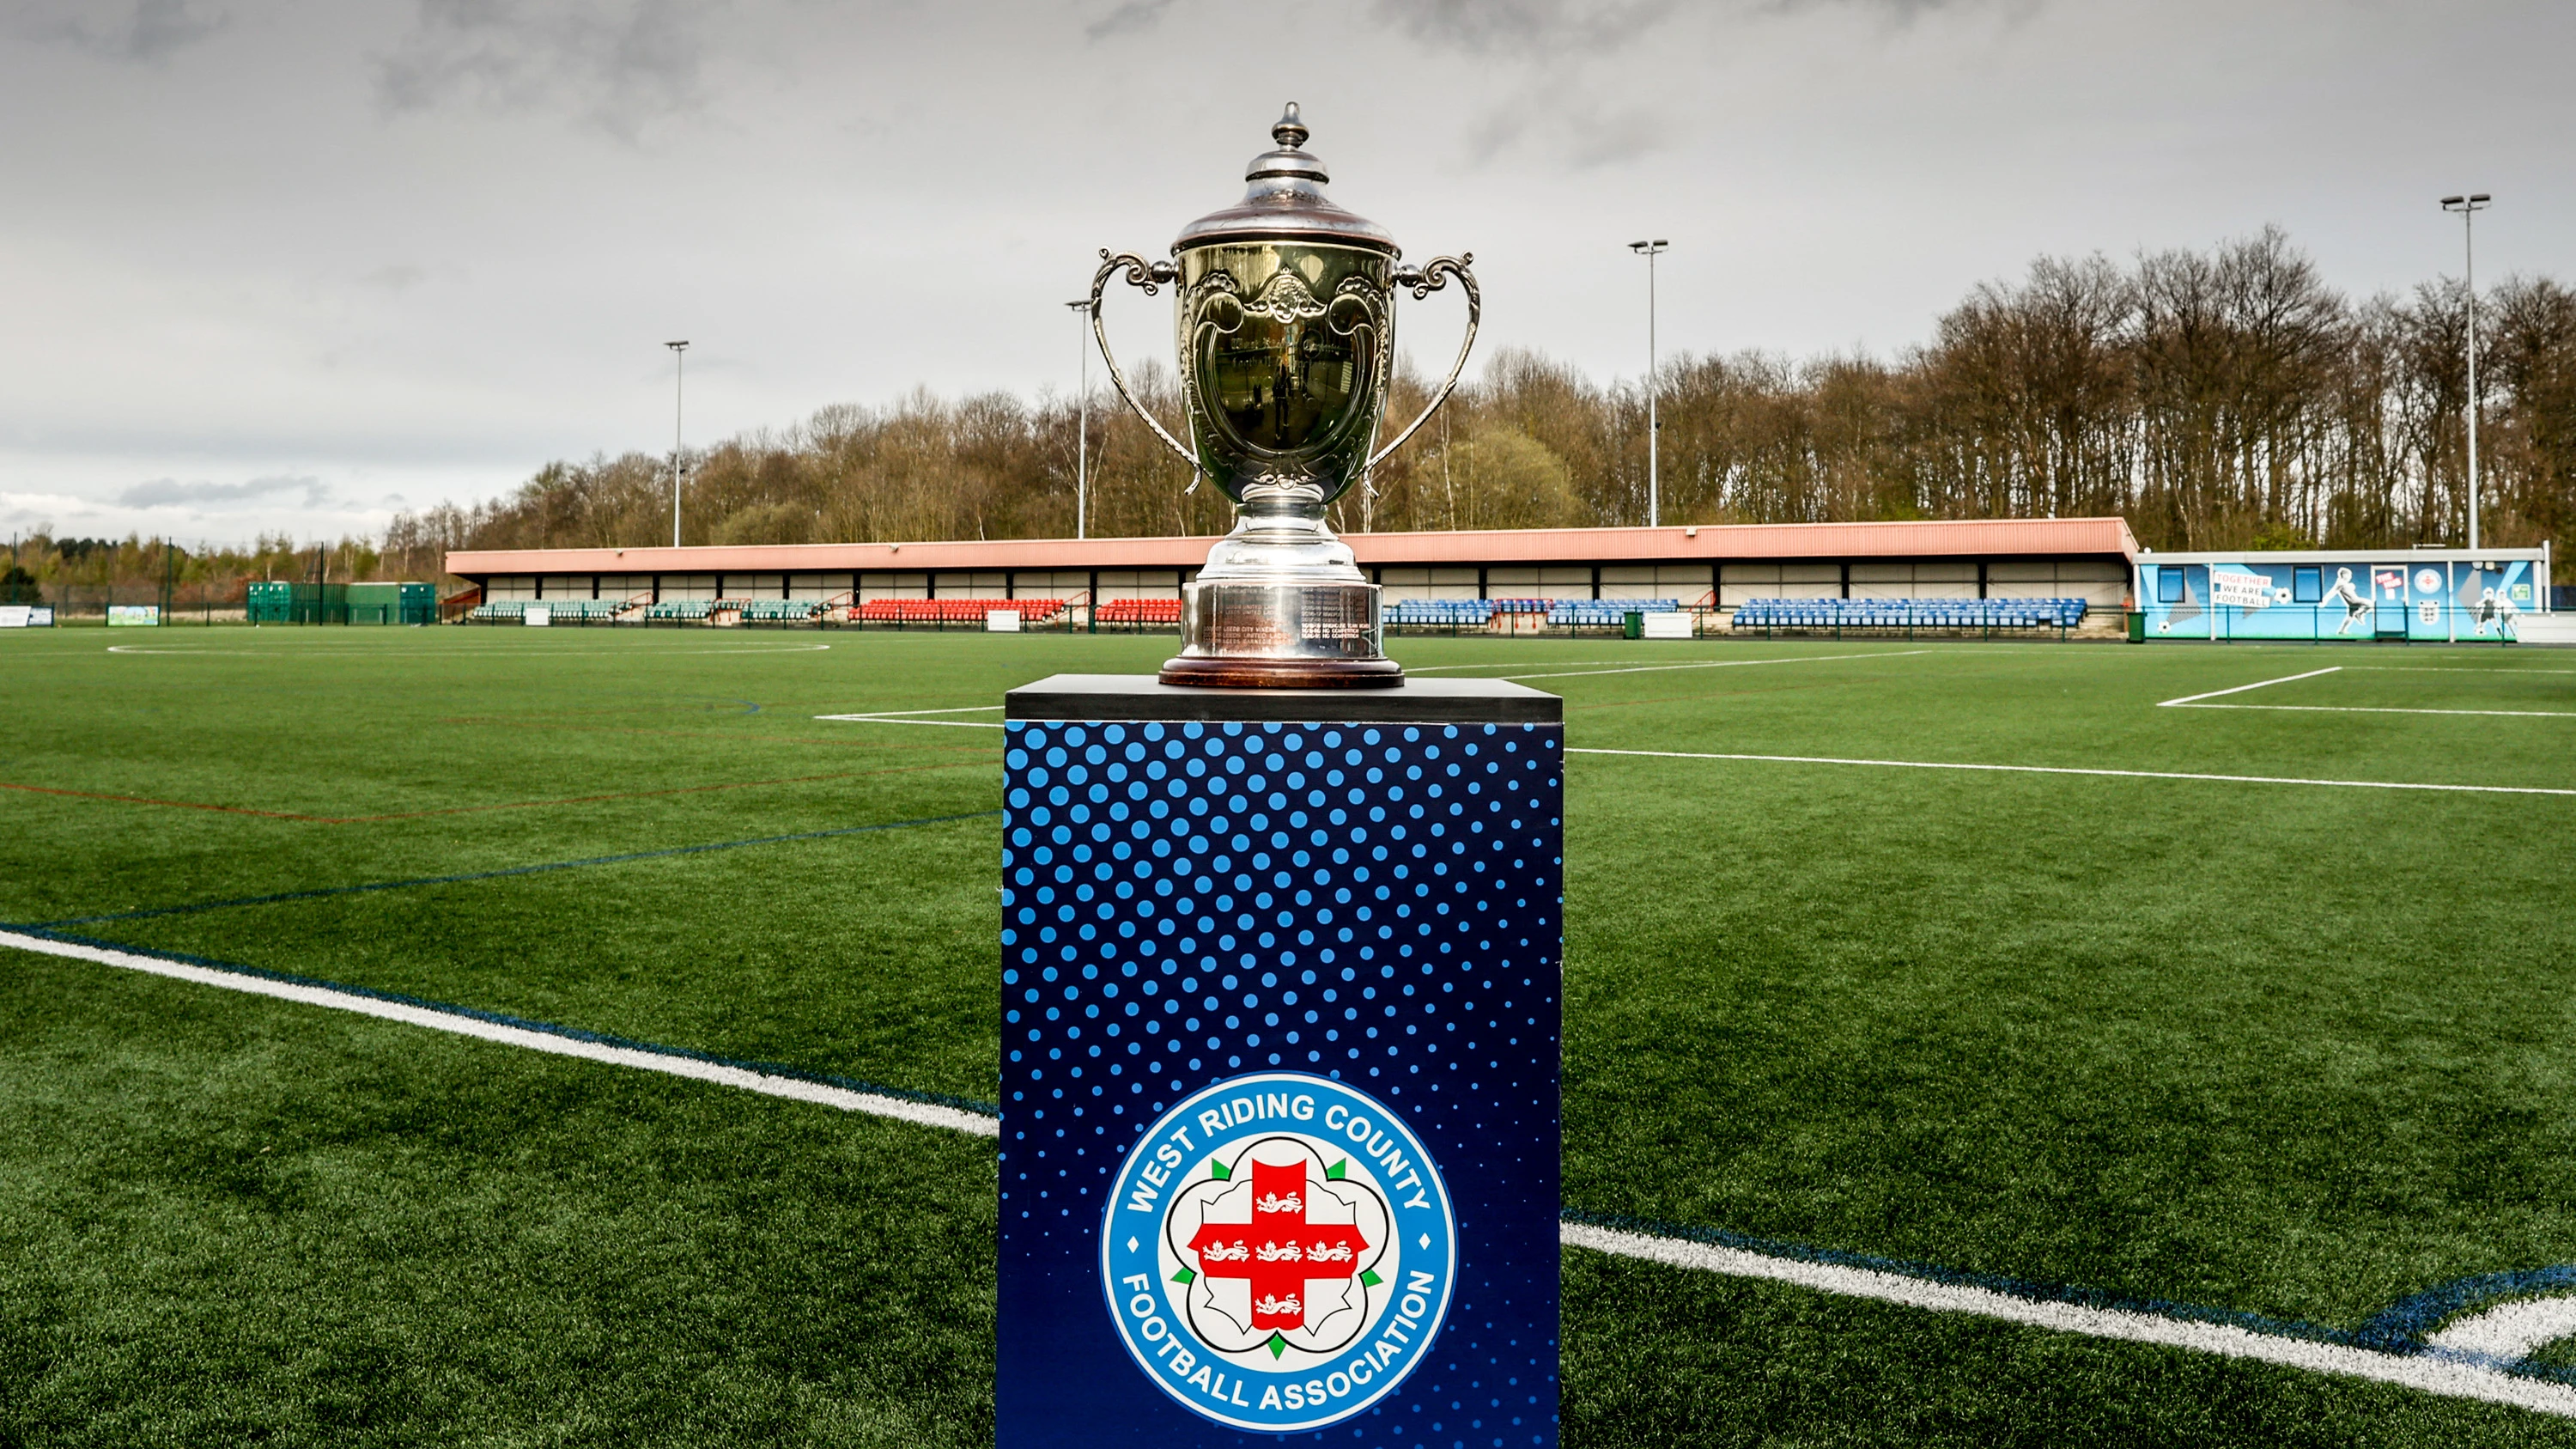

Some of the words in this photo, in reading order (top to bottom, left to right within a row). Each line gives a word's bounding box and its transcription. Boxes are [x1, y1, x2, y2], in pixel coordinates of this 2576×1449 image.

[2217, 573, 2269, 586] TOGETHER
[2223, 585, 2238, 594] WE
[2242, 587, 2260, 595] ARE
[2216, 594, 2267, 606] FOOTBALL
[1127, 1125, 1195, 1213] WEST
[1198, 1093, 1315, 1138] RIDING
[1325, 1105, 1431, 1209] COUNTY
[1122, 1273, 1249, 1408] FOOTBALL
[1258, 1270, 1435, 1411] ASSOCIATION
